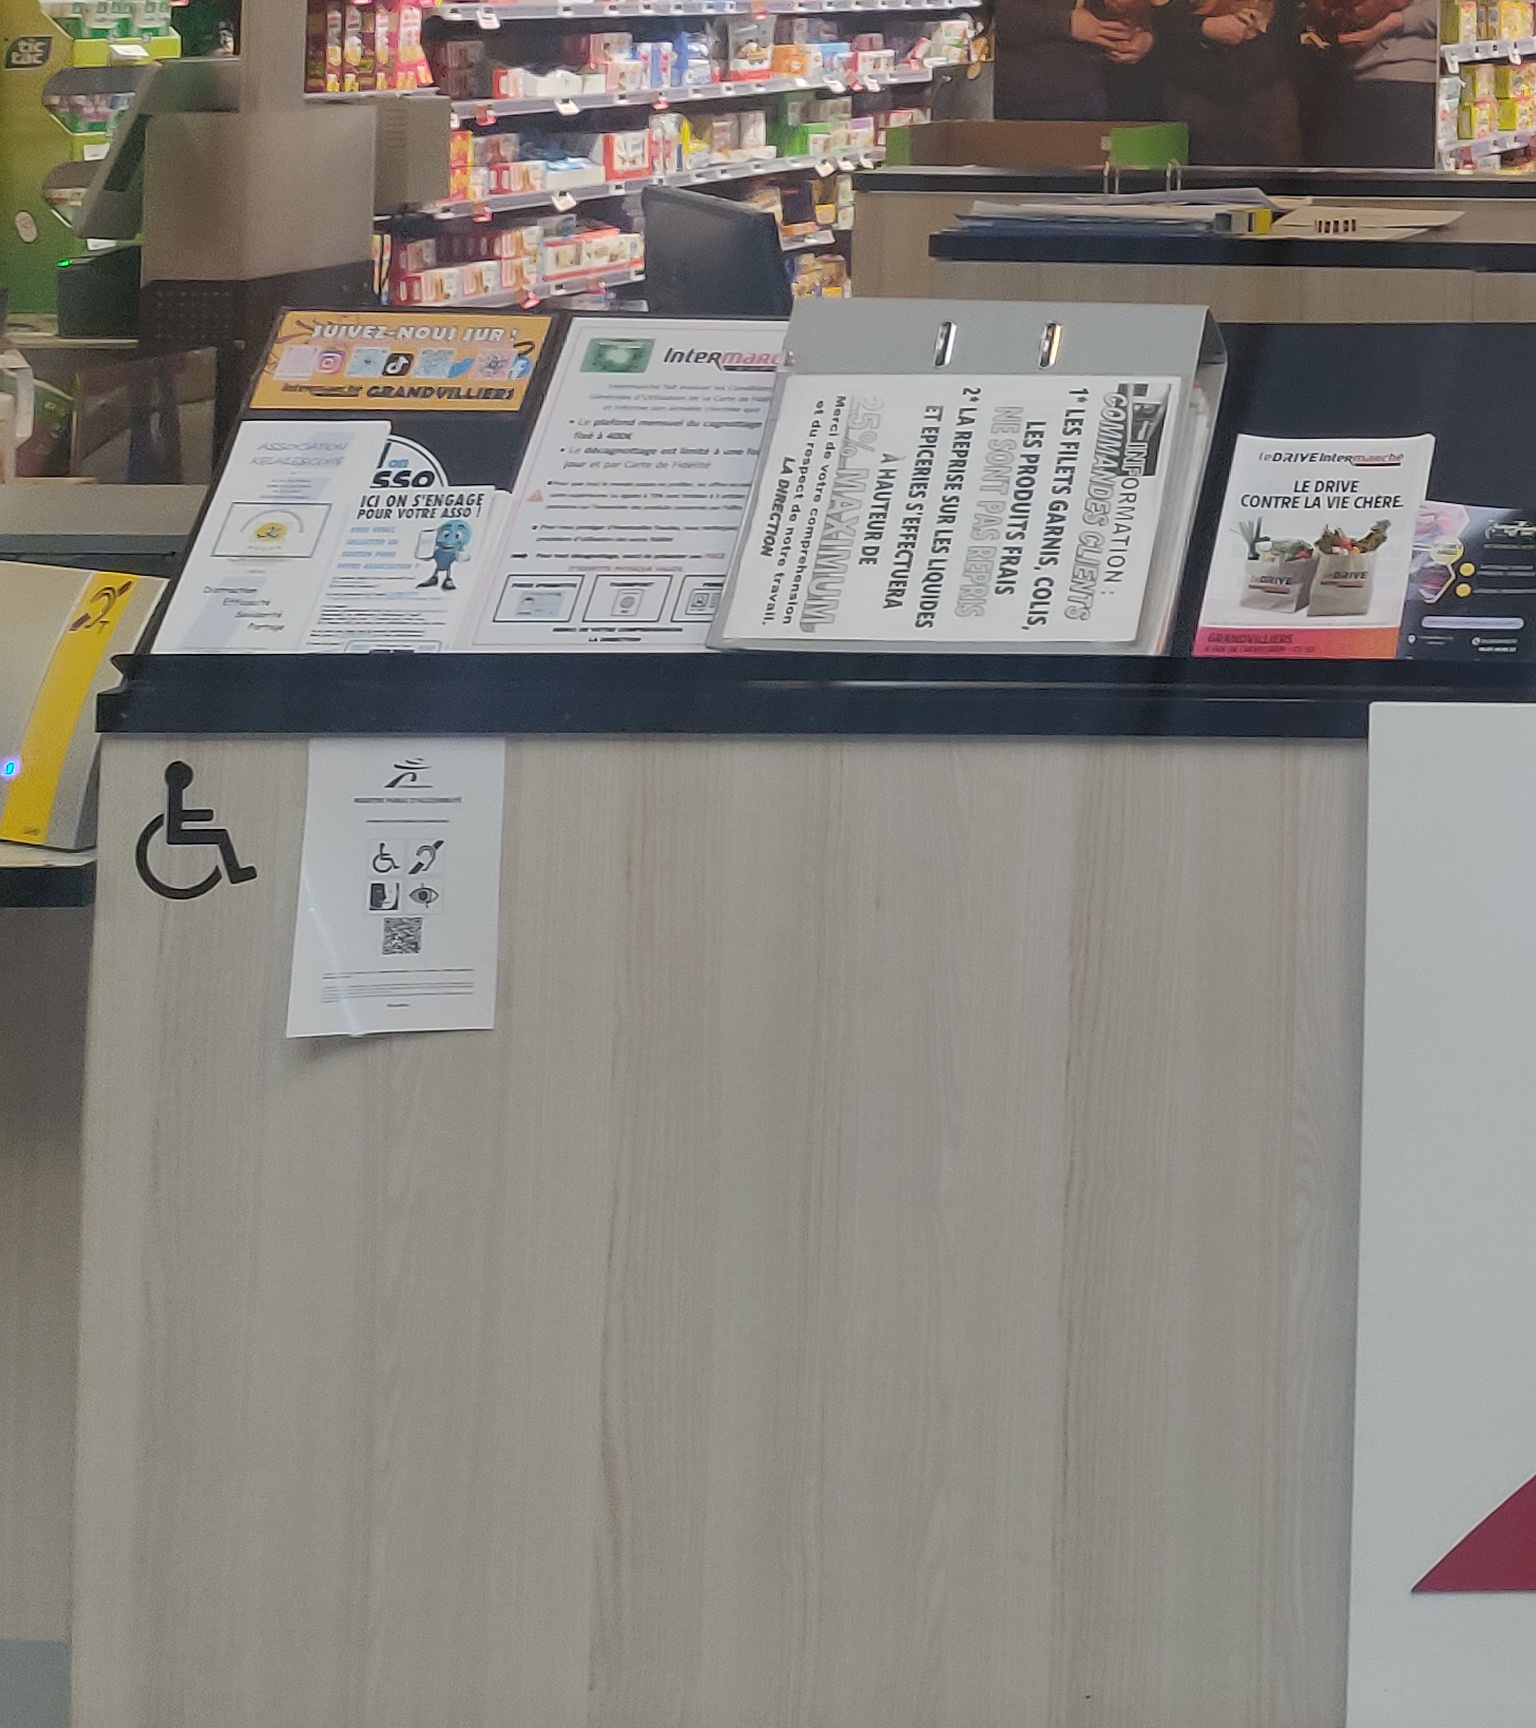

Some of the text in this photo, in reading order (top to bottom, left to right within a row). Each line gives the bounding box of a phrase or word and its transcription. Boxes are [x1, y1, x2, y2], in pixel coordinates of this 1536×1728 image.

[663, 348, 780, 371] Intermarc
[814, 400, 824, 416] et
[828, 395, 847, 436] Merci
[956, 407, 978, 426] LA
[1062, 408, 1086, 437] LES
[808, 420, 821, 438] du
[823, 441, 836, 459] de
[943, 430, 973, 492] REPRISE
[1051, 441, 1080, 495] FILETS
[369, 470, 435, 488] SSO
[798, 441, 814, 499] respect
[813, 465, 828, 502] votre
[1294, 480, 1359, 493] LE DRIVE
[356, 506, 472, 520] POUR VOTRE ASSO
[360, 493, 486, 508] ICI ON S'ENGAGE
[760, 456, 796, 557] LA DIRECTION
[788, 504, 801, 522] de
[863, 468, 898, 541] HAUTEUR
[882, 405, 944, 609] ET EPICERIES S'EFFECTUERA
[936, 495, 960, 525] SUR
[954, 406, 1024, 618] NE SONT PAS REPRIS
[994, 421, 1047, 596] LES PRODUITS FRAIS
[1064, 392, 1127, 622] COMMANDES CLIENTS
[1103, 441, 1148, 583] INFORMATION
[1240, 495, 1300, 508] CONTRE
[1304, 496, 1321, 508] LA
[1327, 495, 1349, 508] VIE
[777, 527, 794, 567] notre
[931, 530, 954, 555] LES
[1033, 499, 1069, 571] GARNIS,
[858, 546, 880, 565] DE
[915, 558, 948, 629] LIQUIDES
[1021, 576, 1055, 630] COLIS,
